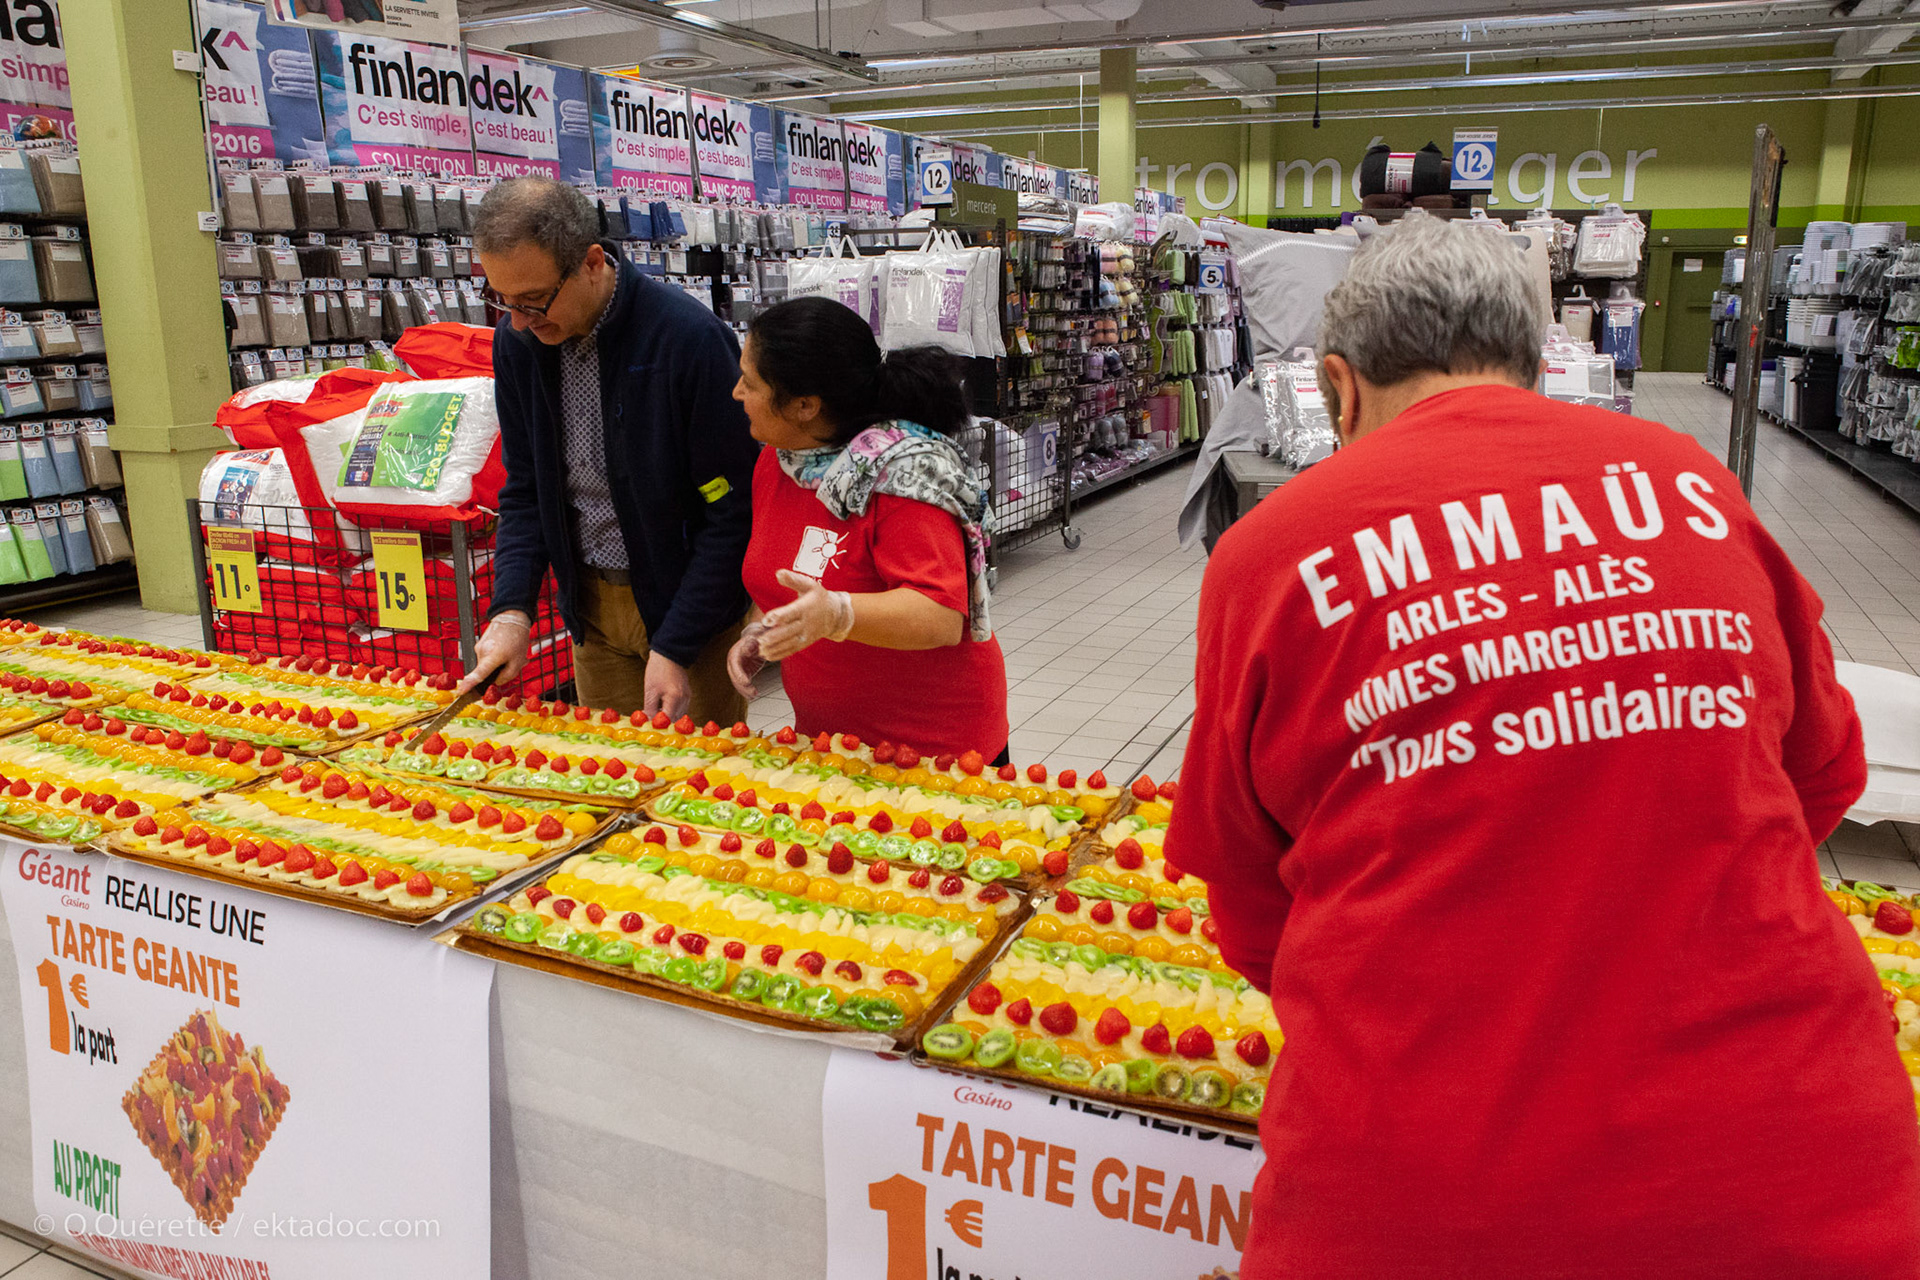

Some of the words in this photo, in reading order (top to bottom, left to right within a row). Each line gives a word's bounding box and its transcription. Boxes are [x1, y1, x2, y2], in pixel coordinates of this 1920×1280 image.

[213, 132, 262, 155] 2016
[410, 110, 468, 138] simple,
[371, 152, 466, 175] COLLECTION
[478, 160, 523, 178] BLANC
[620, 175, 688, 195] COLLECTION
[702, 180, 730, 198] BLANC
[731, 184, 751, 199] 2016
[794, 193, 843, 208] COLLECTION
[851, 195, 870, 209] BLANC
[967, 199, 997, 215] mercerie
[422, 395, 464, 487] ECO-BUDGET
[1298, 461, 1730, 629] EMMAÜS
[1386, 582, 1508, 651] ARLES
[1553, 554, 1655, 607] ALÈS
[1461, 607, 1754, 685] MARGUERITTES
[18, 848, 92, 896] Géant
[60, 894, 91, 911] Casino
[105, 874, 202, 929] REALISE
[209, 901, 267, 946] UNE
[46, 914, 127, 975] TARTE
[132, 937, 241, 1009] GEANTE
[71, 1010, 86, 1054] la
[89, 1020, 118, 1066] part
[953, 1085, 1013, 1112] Casino
[53, 1139, 72, 1198] AU
[73, 1146, 122, 1220] PROFIT
[916, 1112, 1077, 1208] TARTE
